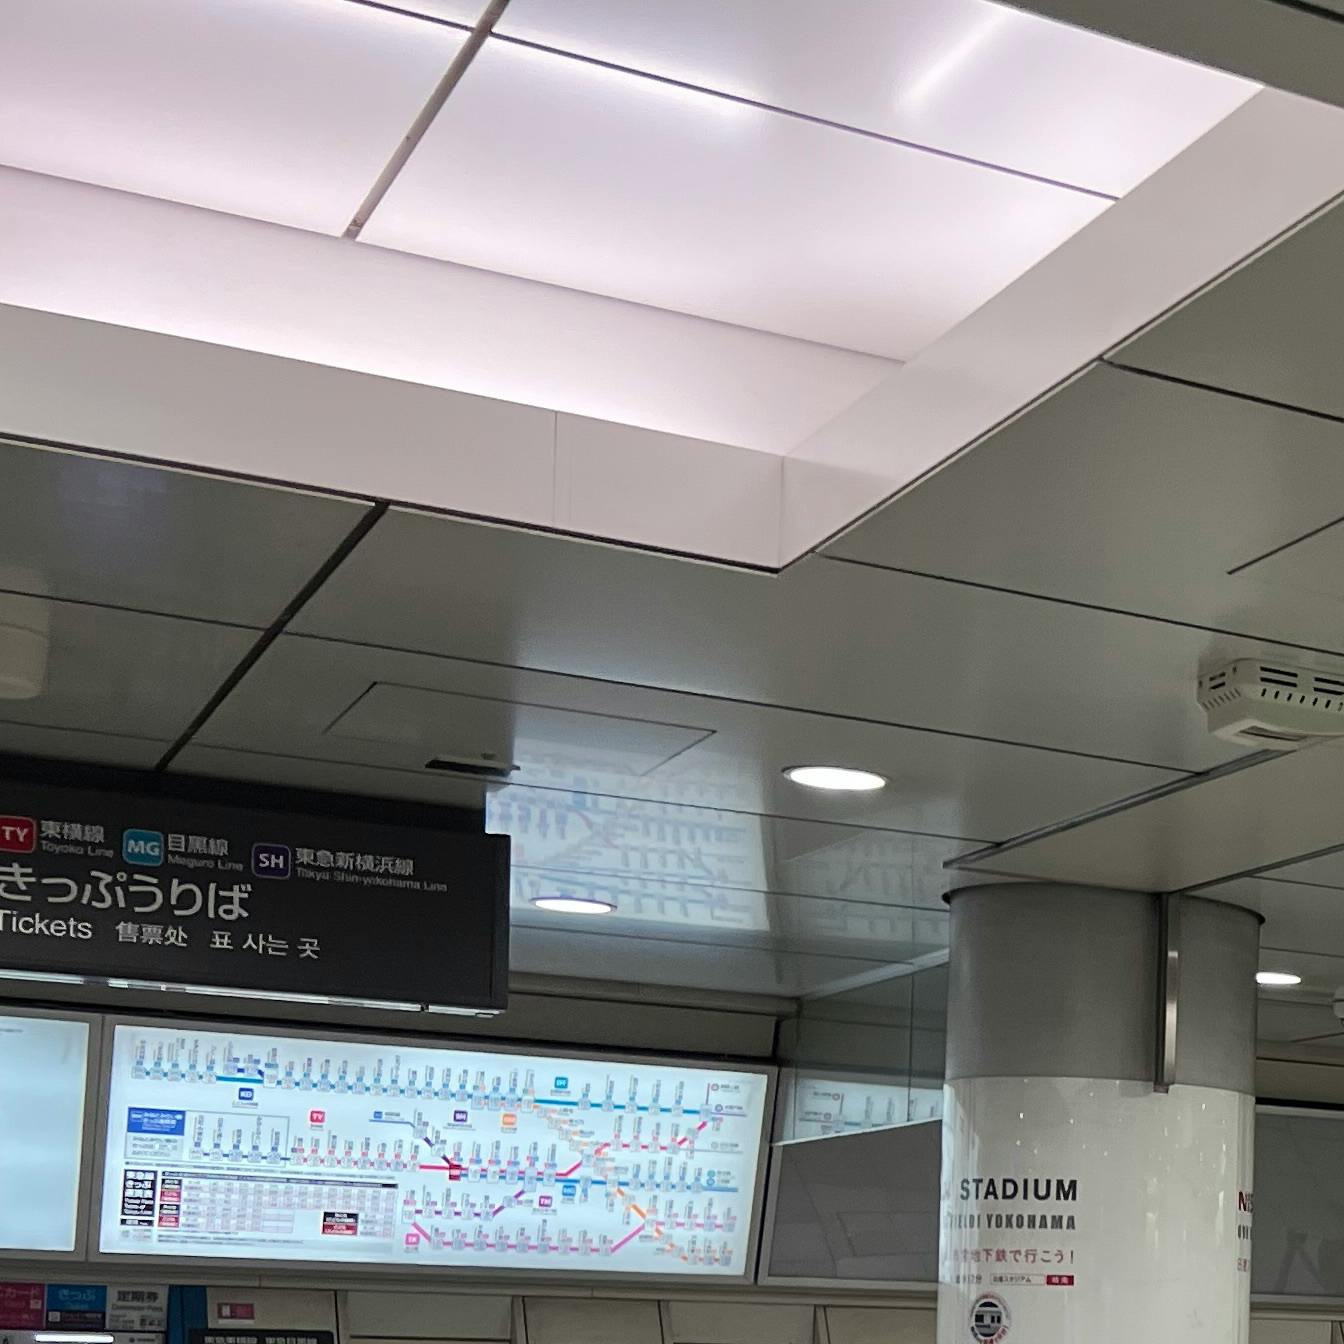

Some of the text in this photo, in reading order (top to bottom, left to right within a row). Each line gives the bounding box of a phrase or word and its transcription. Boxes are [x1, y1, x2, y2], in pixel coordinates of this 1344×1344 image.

[2, 824, 29, 843] TY
[127, 839, 161, 857] MG
[258, 853, 284, 869] SH
[0, 862, 253, 921] きっぷうりば
[0, 909, 93, 940] Tickets
[115, 920, 188, 948] 售票处
[210, 930, 321, 960] 표 사는 곳
[960, 1178, 1078, 1201] STADIUM
[986, 1214, 1076, 1230] YOKOHAMA
